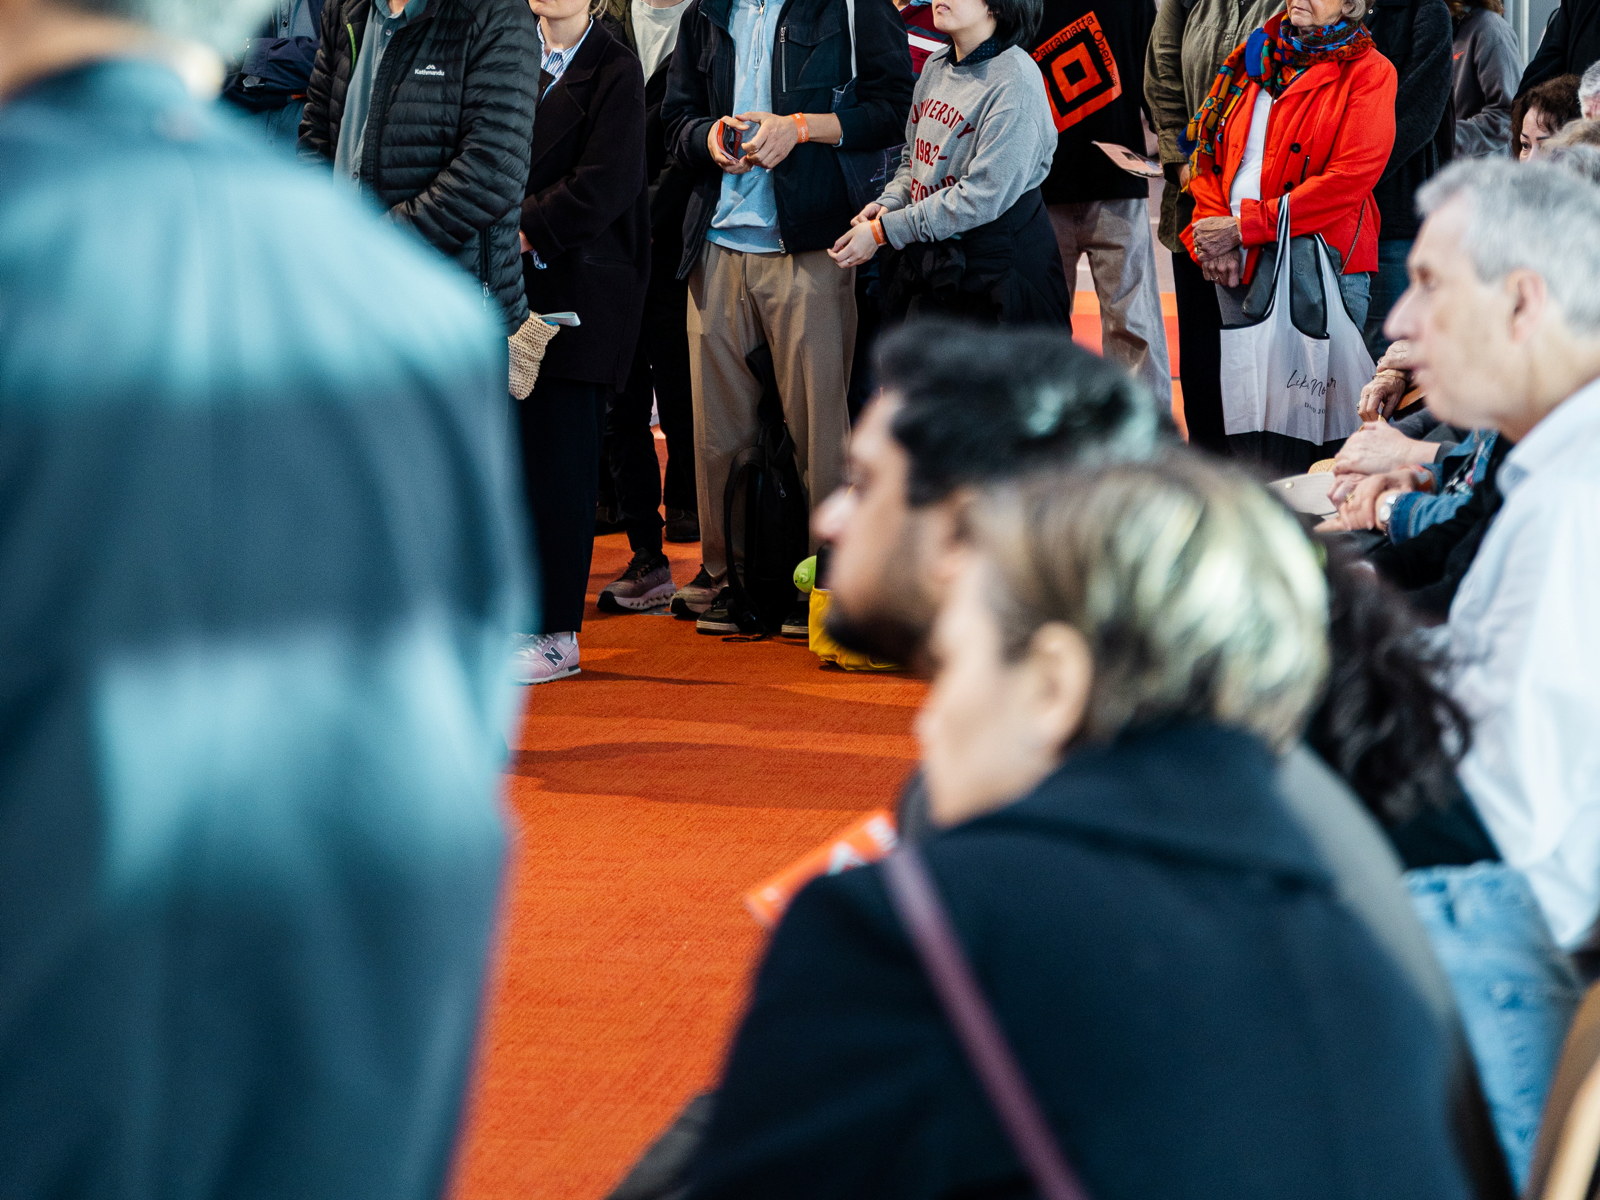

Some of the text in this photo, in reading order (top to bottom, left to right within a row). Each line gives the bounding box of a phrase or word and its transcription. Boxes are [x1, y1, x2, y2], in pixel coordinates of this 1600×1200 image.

[1031, 15, 1095, 59] Parramatta
[1092, 29, 1113, 68] Open
[1286, 369, 1310, 390] Lik
[543, 645, 565, 667] N
